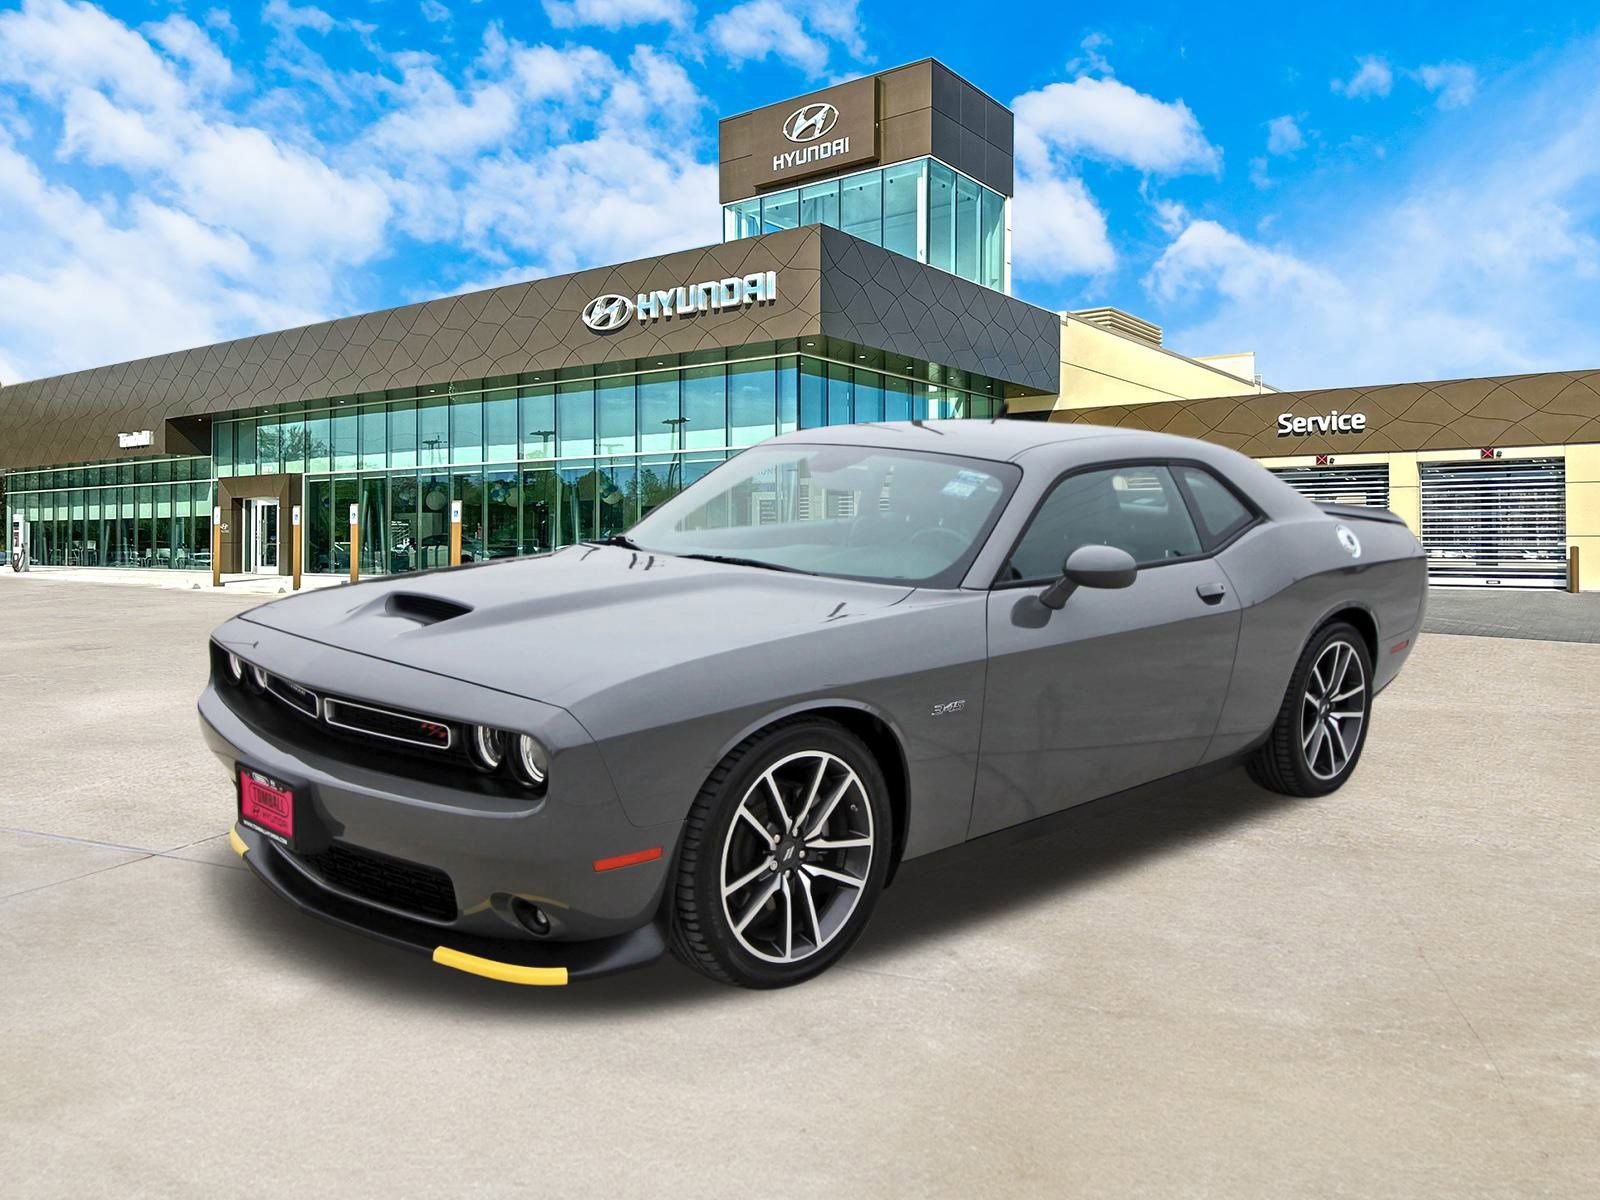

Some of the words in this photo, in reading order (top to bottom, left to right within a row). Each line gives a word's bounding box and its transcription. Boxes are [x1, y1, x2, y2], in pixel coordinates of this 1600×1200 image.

[772, 137, 850, 170] HYUNDAI
[636, 270, 777, 321] HYUNDAI
[1277, 410, 1367, 436] Service
